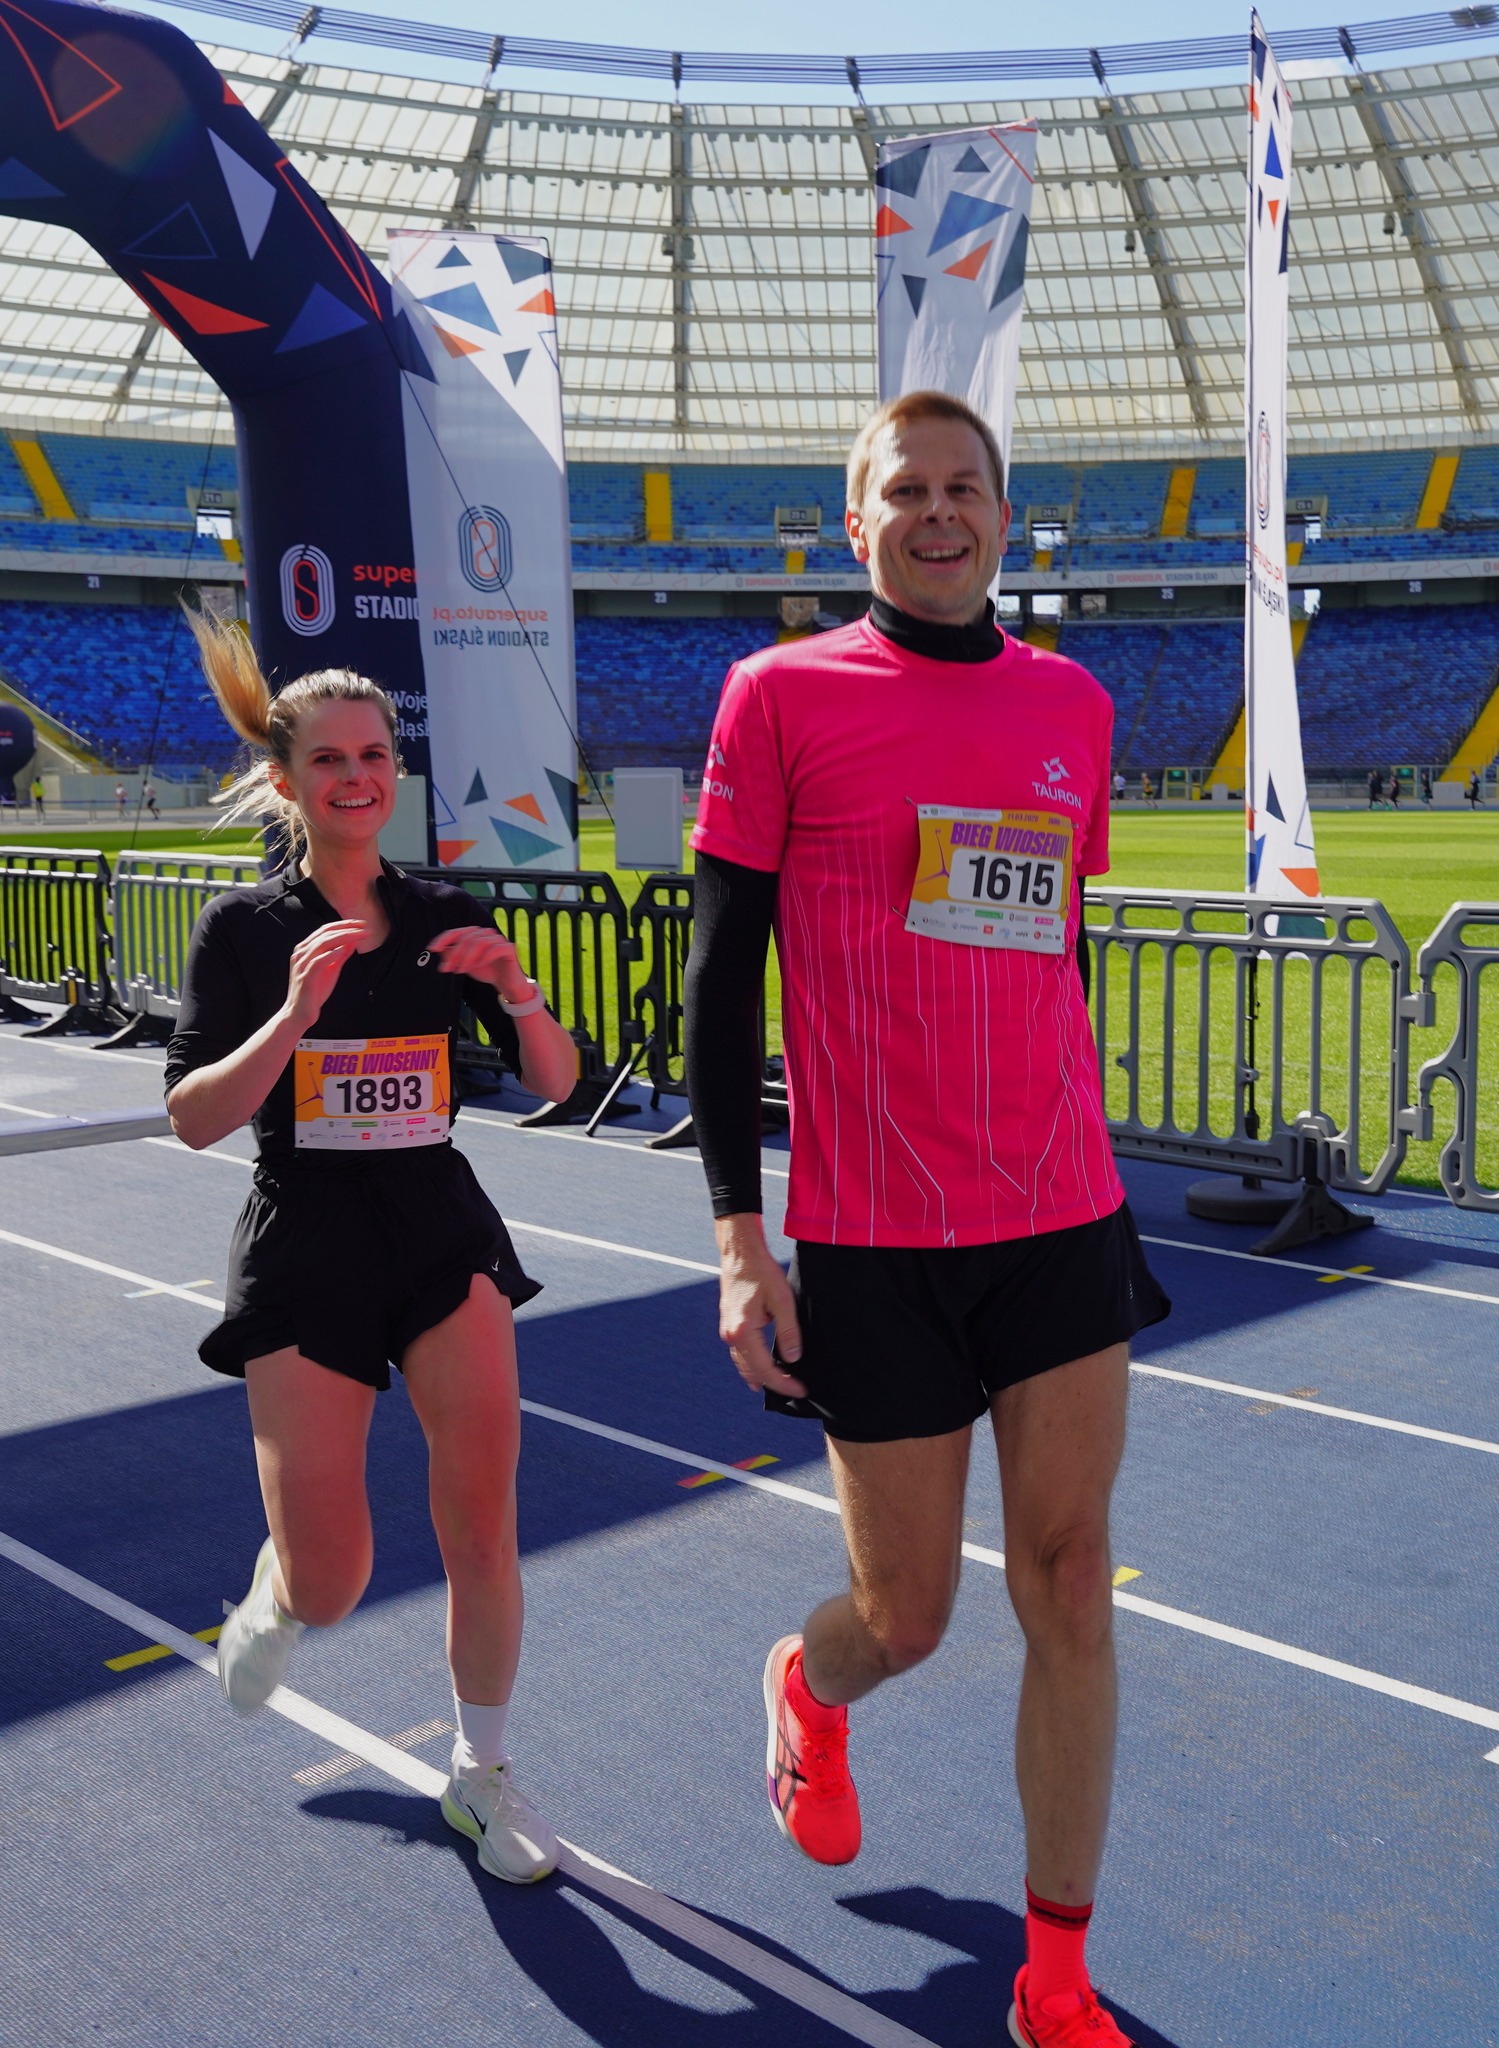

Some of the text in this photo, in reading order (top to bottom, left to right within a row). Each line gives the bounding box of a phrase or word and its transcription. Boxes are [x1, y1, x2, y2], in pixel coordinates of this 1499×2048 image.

[1161, 588, 1174, 600] 25
[1031, 781, 1082, 810] TAURON
[950, 822, 1070, 860] BIEG WIOSENNY
[968, 855, 1055, 906] 1615
[321, 1049, 440, 1075] BIEG WIOSENNY
[336, 1075, 422, 1114] 1893
